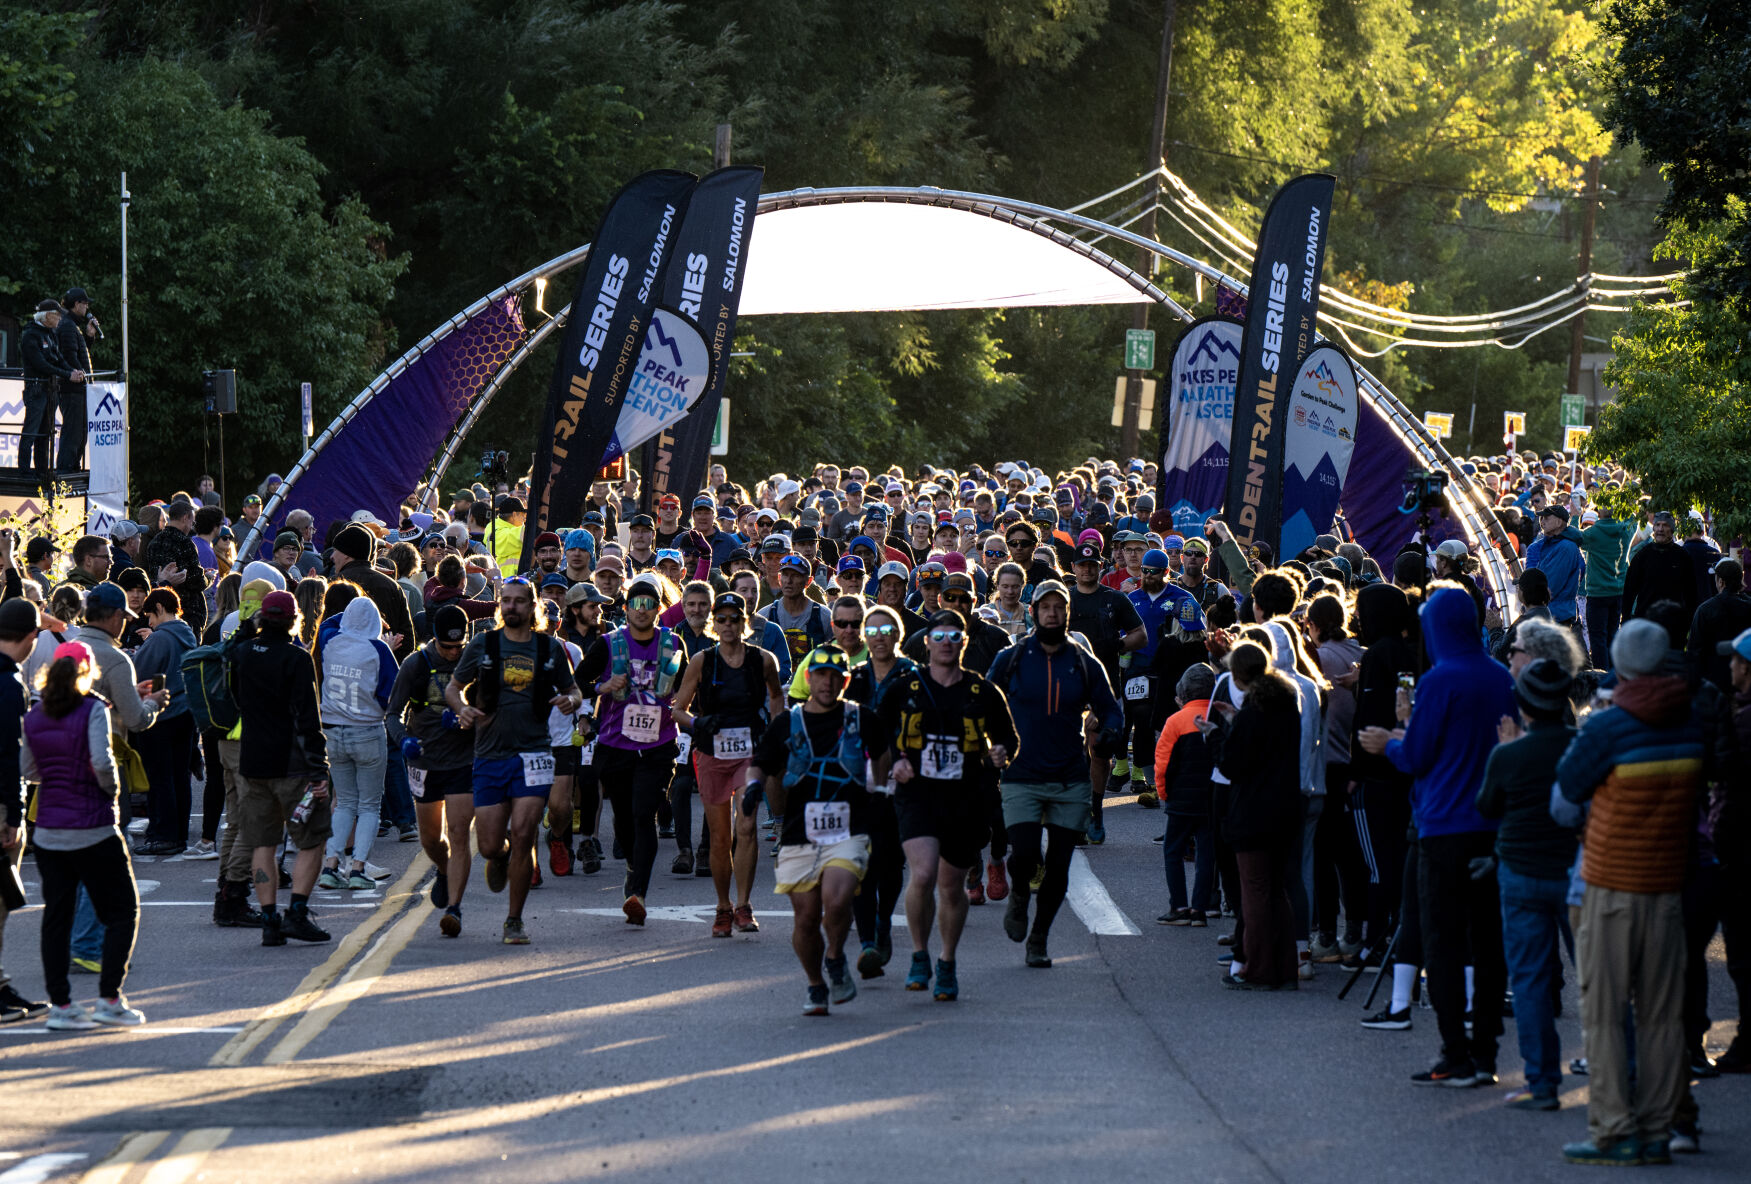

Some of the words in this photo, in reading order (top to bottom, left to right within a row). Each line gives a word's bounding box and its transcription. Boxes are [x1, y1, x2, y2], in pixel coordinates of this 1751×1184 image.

[723, 197, 747, 292] SALOMON
[638, 203, 676, 304] SALOMON
[1302, 205, 1321, 303] SALOMON
[679, 251, 708, 322] RIES
[720, 304, 730, 319] BY
[1300, 315, 1310, 330] BY
[605, 336, 635, 406] SUPPORTED
[630, 315, 641, 335] BY
[643, 359, 690, 392] PEAK
[1180, 369, 1214, 384] PIKES
[1219, 369, 1237, 384] PE
[633, 371, 688, 412] THON
[1180, 386, 1236, 403] MARATH
[624, 388, 672, 422] CENT
[1196, 403, 1233, 419] ASCE
[89, 421, 110, 433] PIKES
[94, 433, 122, 447] ASCENT
[330, 664, 362, 679] MILLER
[328, 677, 360, 713] 21
[1128, 685, 1145, 695] 1126
[628, 716, 655, 729] 1157
[720, 740, 747, 752] 1163
[530, 759, 552, 771] 1139
[813, 816, 842, 830] 1181
